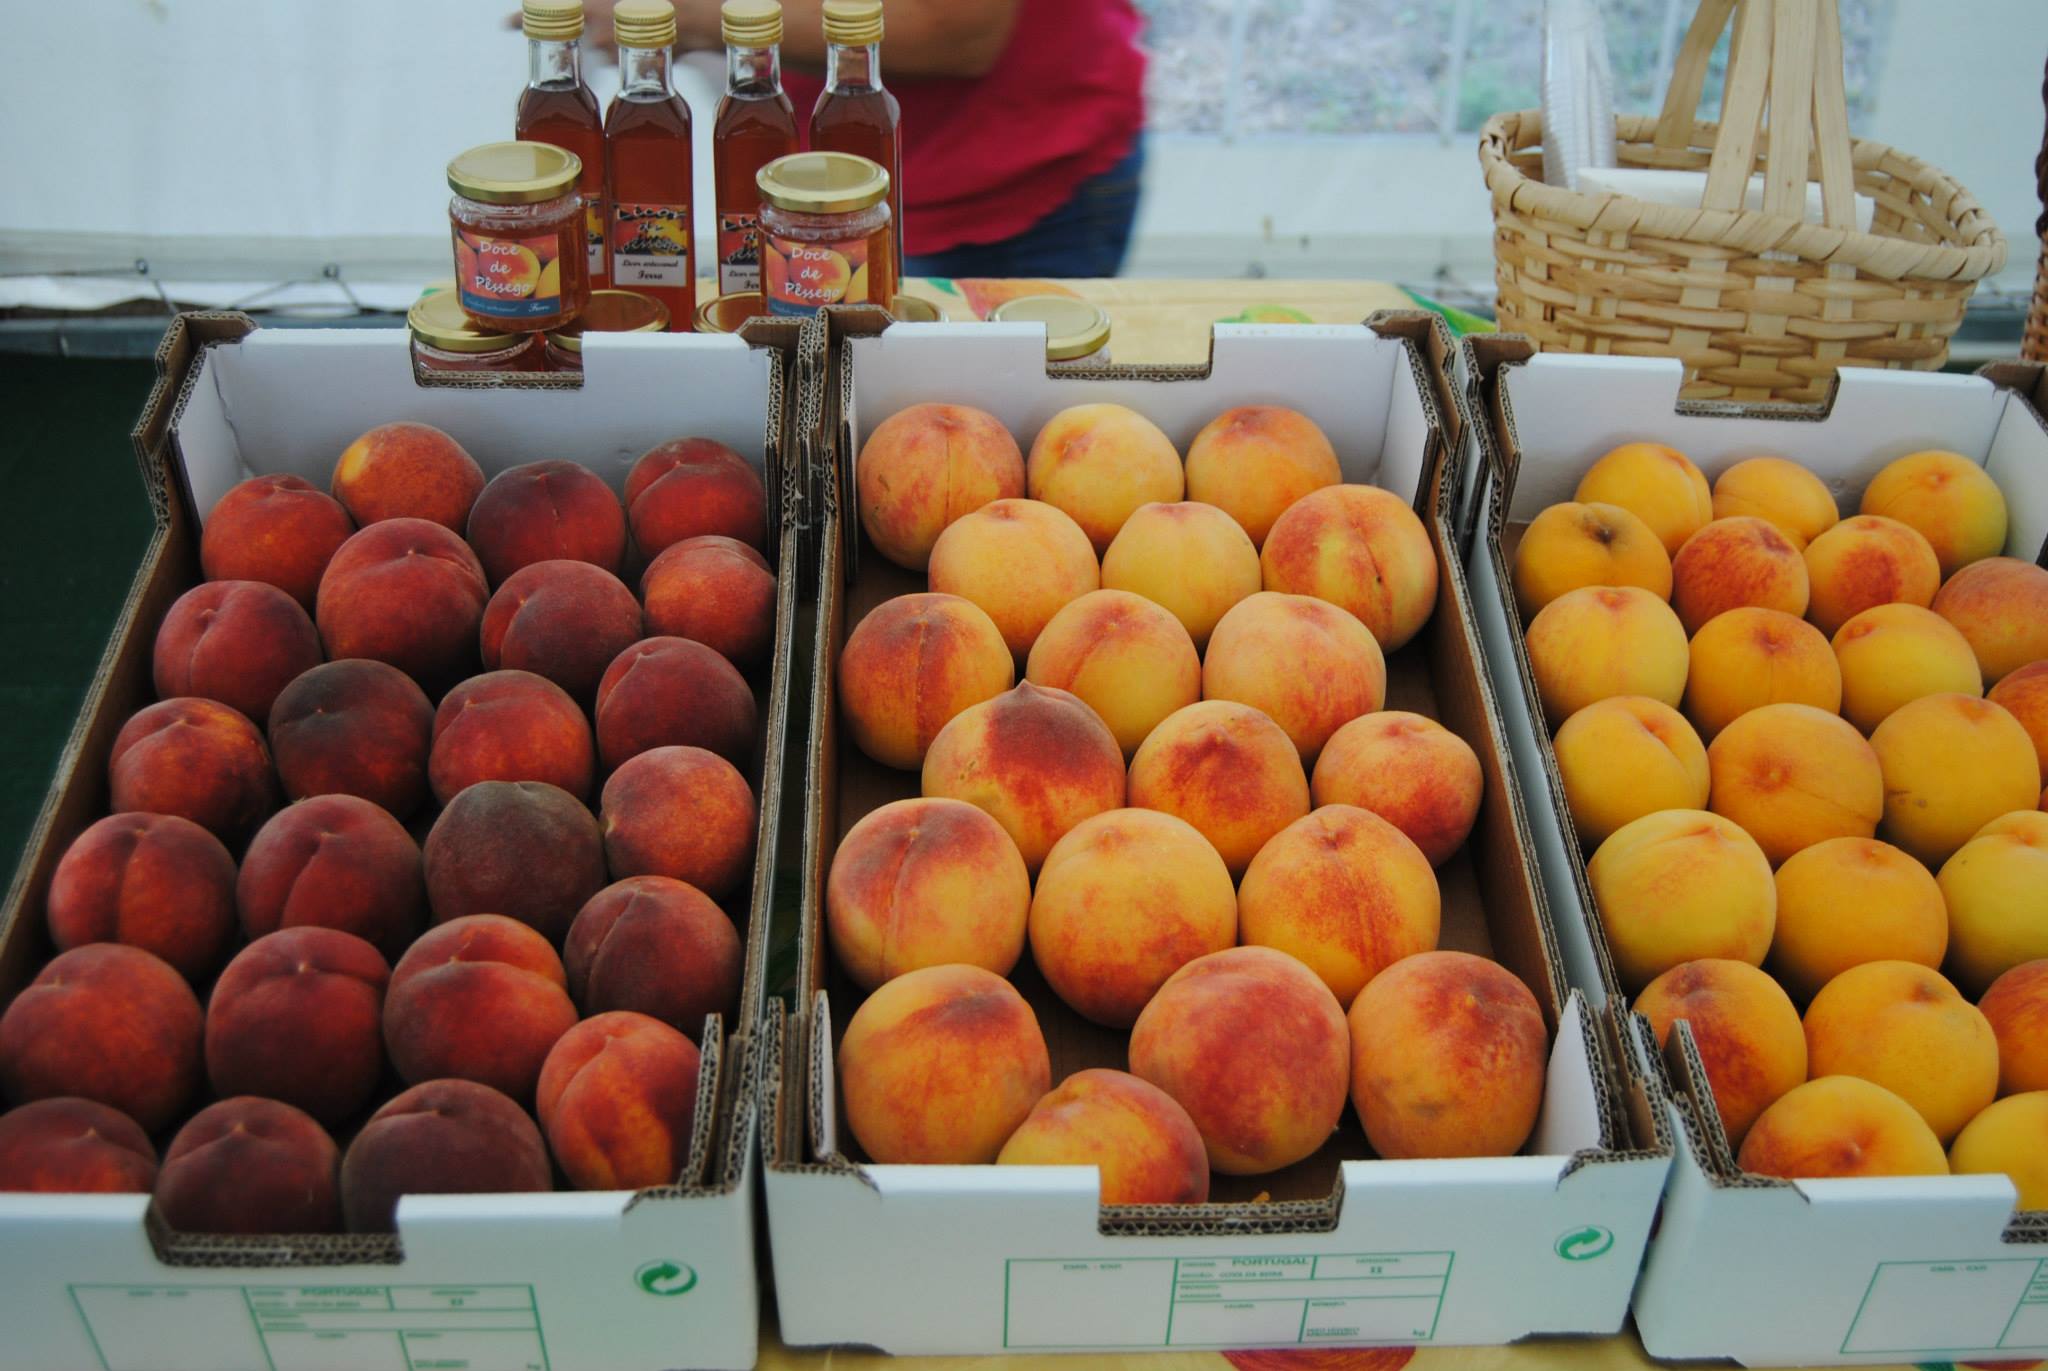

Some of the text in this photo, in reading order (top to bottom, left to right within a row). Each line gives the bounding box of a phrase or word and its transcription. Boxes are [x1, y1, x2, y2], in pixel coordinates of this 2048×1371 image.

[480, 240, 520, 255] Doce
[791, 247, 832, 261] Doce
[489, 260, 512, 273] de
[800, 267, 823, 280] de
[474, 275, 534, 297] Pêssego
[784, 281, 841, 302] Pêssego
[1231, 1255, 1309, 1266] PORTUGAL
